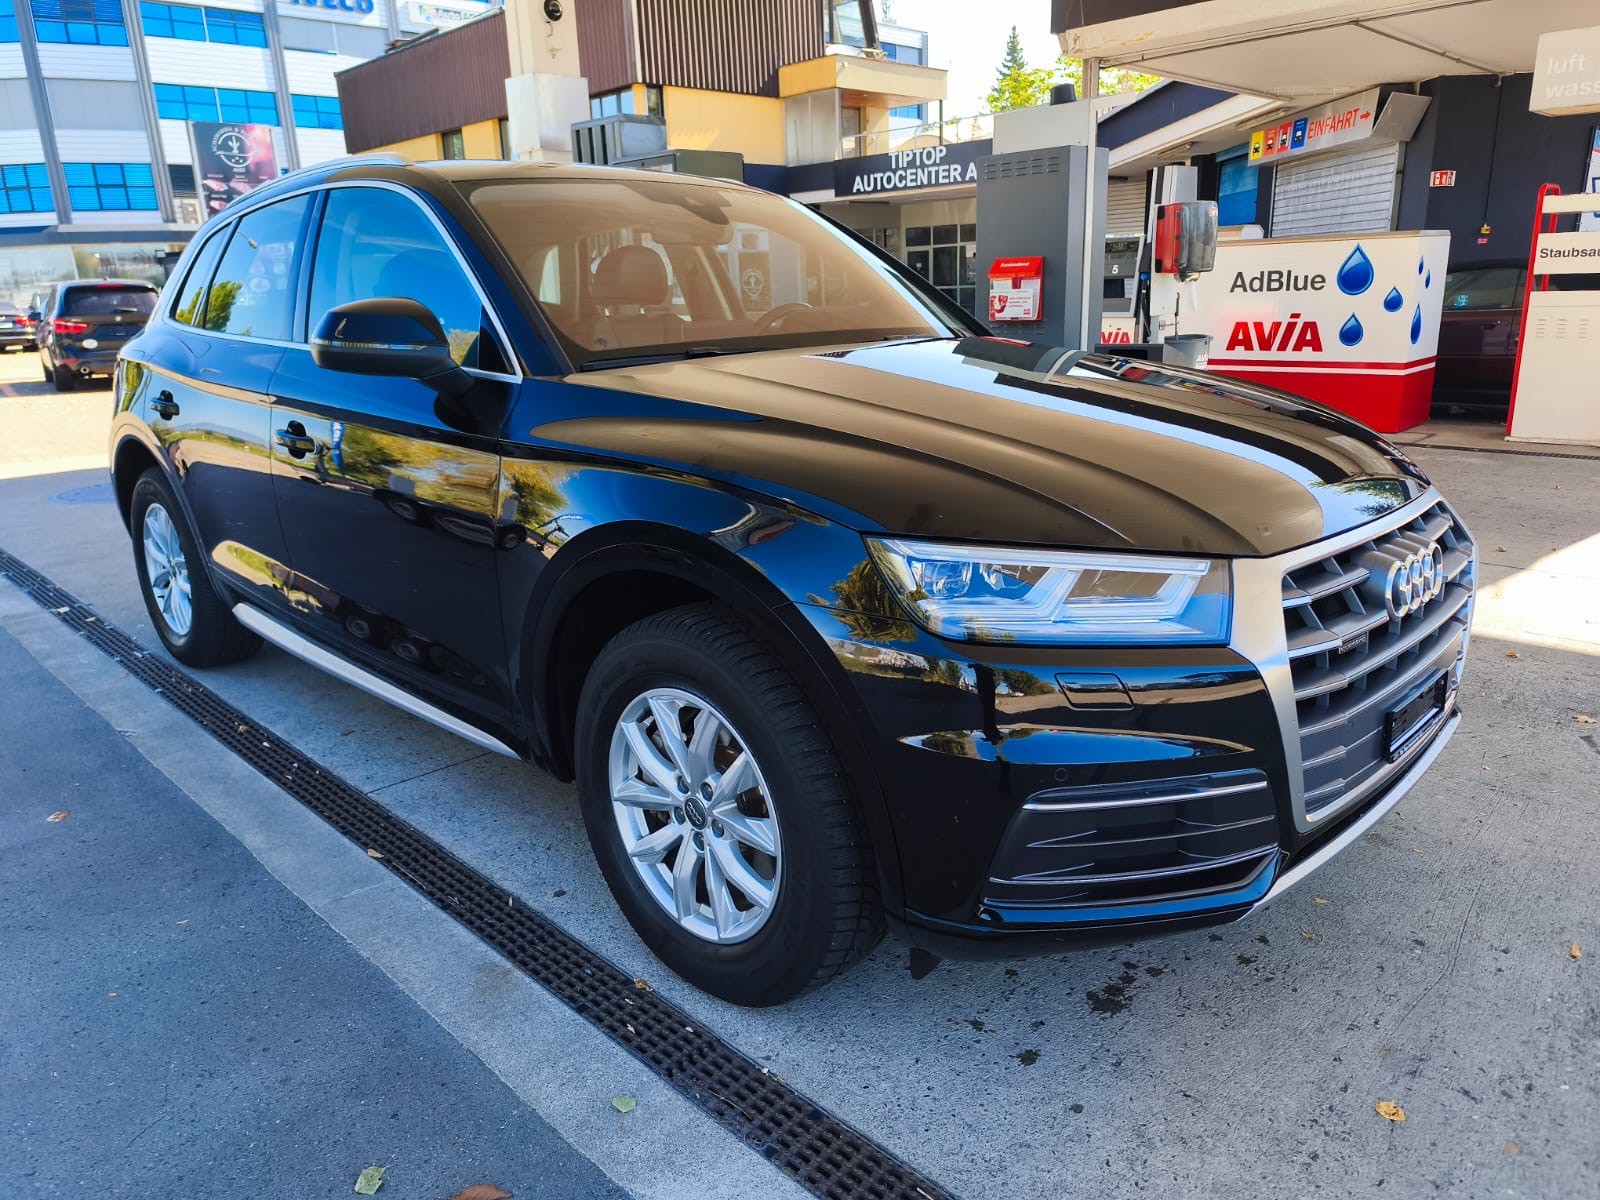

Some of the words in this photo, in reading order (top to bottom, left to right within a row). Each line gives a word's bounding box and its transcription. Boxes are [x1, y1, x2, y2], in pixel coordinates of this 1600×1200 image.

[1547, 53, 1586, 74] luft
[1307, 108, 1360, 140] EINFAHRT
[888, 145, 947, 169] TIPTOP
[852, 164, 962, 193] AUTOCENTER
[1111, 264, 1119, 275] 5
[1229, 269, 1326, 293] AdBlue
[1225, 313, 1323, 352] AVIA
